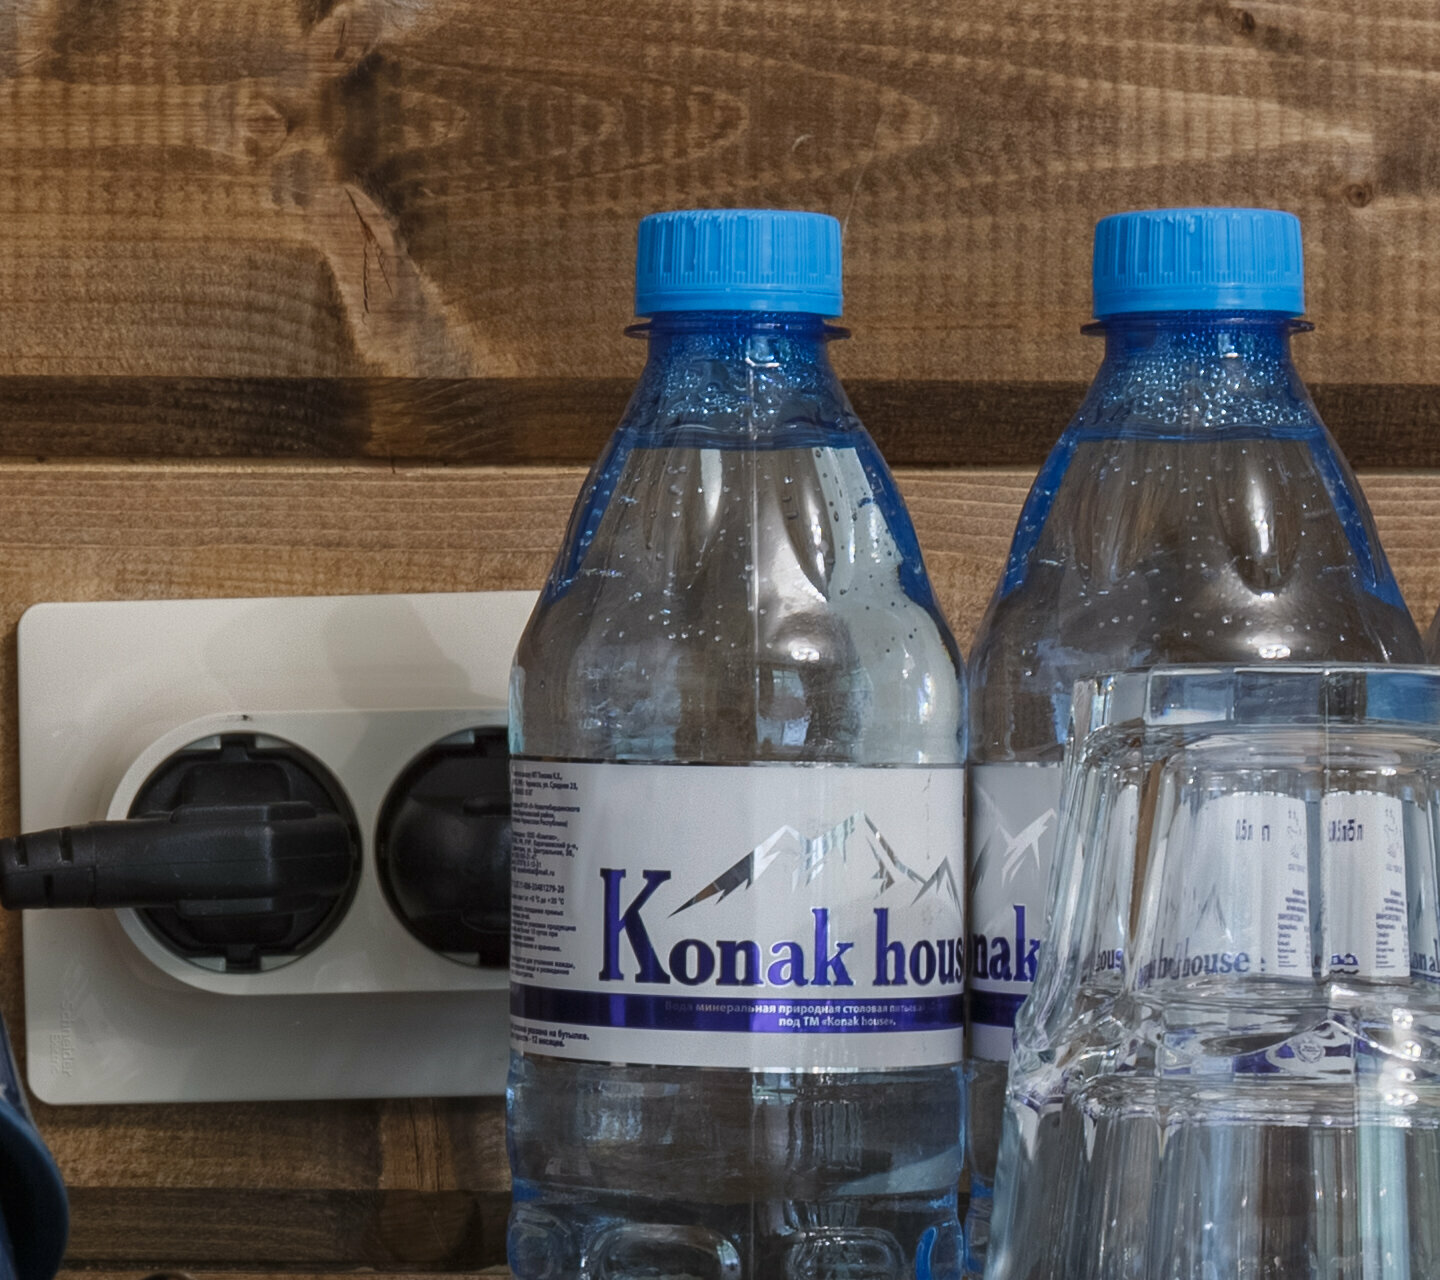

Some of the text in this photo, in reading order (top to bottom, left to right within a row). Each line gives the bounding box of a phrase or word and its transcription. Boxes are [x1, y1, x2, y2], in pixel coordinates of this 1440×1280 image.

[599, 868, 964, 987] Konak hous
[972, 904, 1041, 983] nak
[695, 1004, 776, 1014] минеральная
[778, 1004, 840, 1015] природная
[843, 1005, 888, 1014] столовая
[778, 1016, 800, 1028] под
[803, 1016, 819, 1026] ТМ
